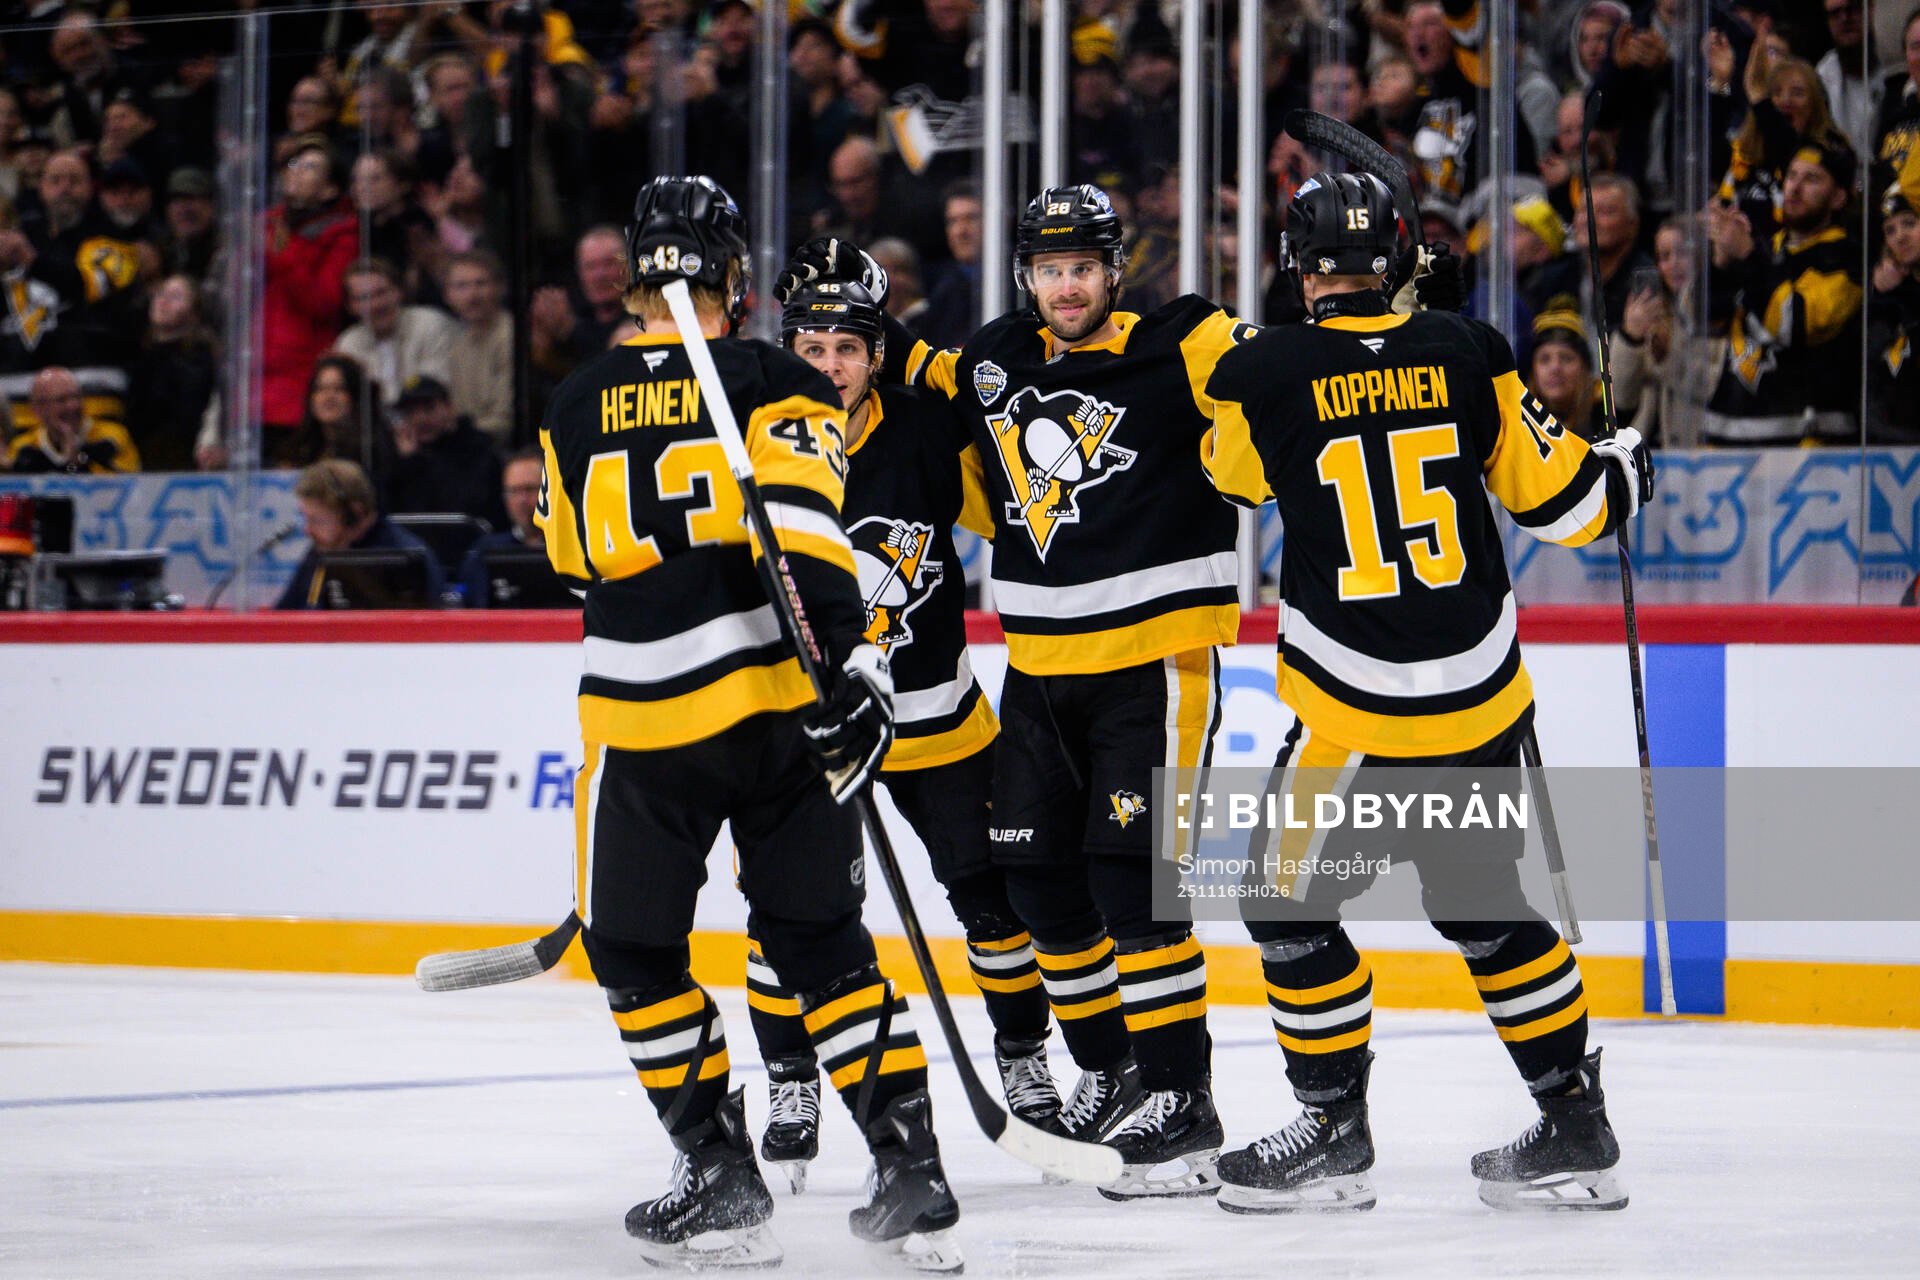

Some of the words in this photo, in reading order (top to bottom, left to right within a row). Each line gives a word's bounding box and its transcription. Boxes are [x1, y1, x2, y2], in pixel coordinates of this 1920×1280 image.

[1046, 202, 1071, 217] 28
[1346, 207, 1370, 231] 15
[1041, 226, 1073, 235] BAUER
[653, 245, 680, 271] 43
[811, 303, 848, 313] CCM
[601, 378, 702, 434] HEINEN
[1311, 366, 1449, 421] KOPPANEN
[582, 436, 752, 583] 43
[1316, 422, 1467, 601] 15
[36, 747, 306, 806] SWEDEN
[334, 751, 499, 810] 2025
[1285, 1153, 1327, 1179] BAUER
[668, 1203, 703, 1231] BAUER
